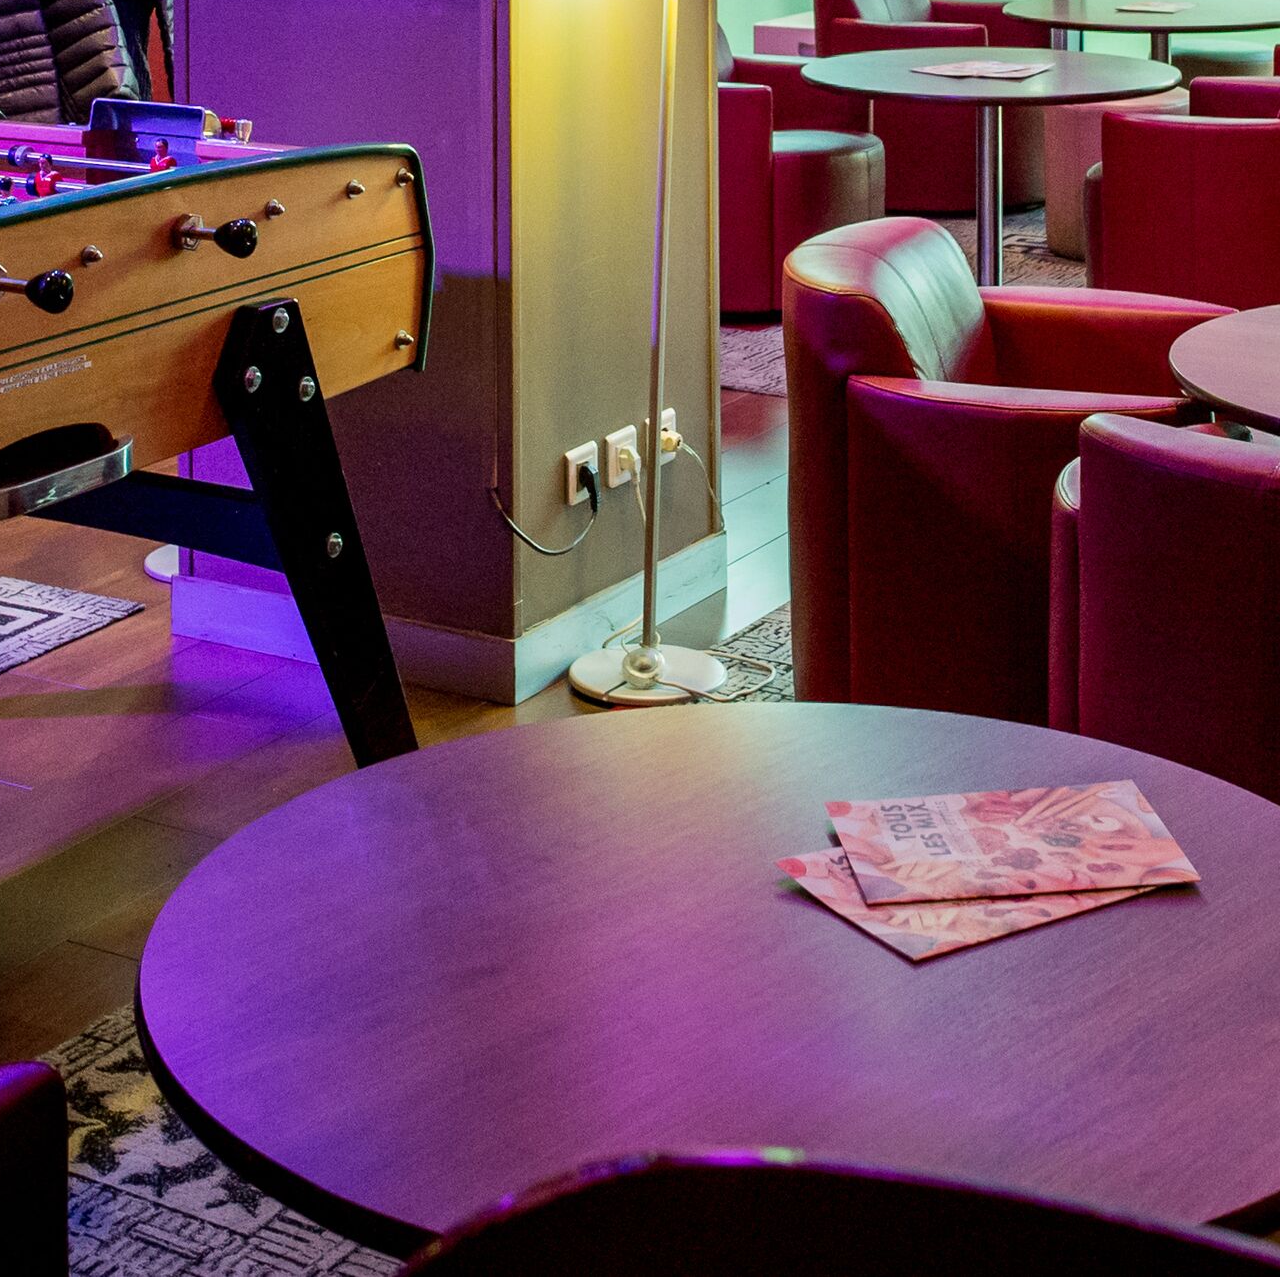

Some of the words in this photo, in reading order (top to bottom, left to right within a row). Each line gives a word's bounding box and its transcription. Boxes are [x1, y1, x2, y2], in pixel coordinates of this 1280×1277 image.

[880, 804, 917, 841] TOUS
[904, 803, 938, 829] MIX
[920, 833, 952, 856] LES
